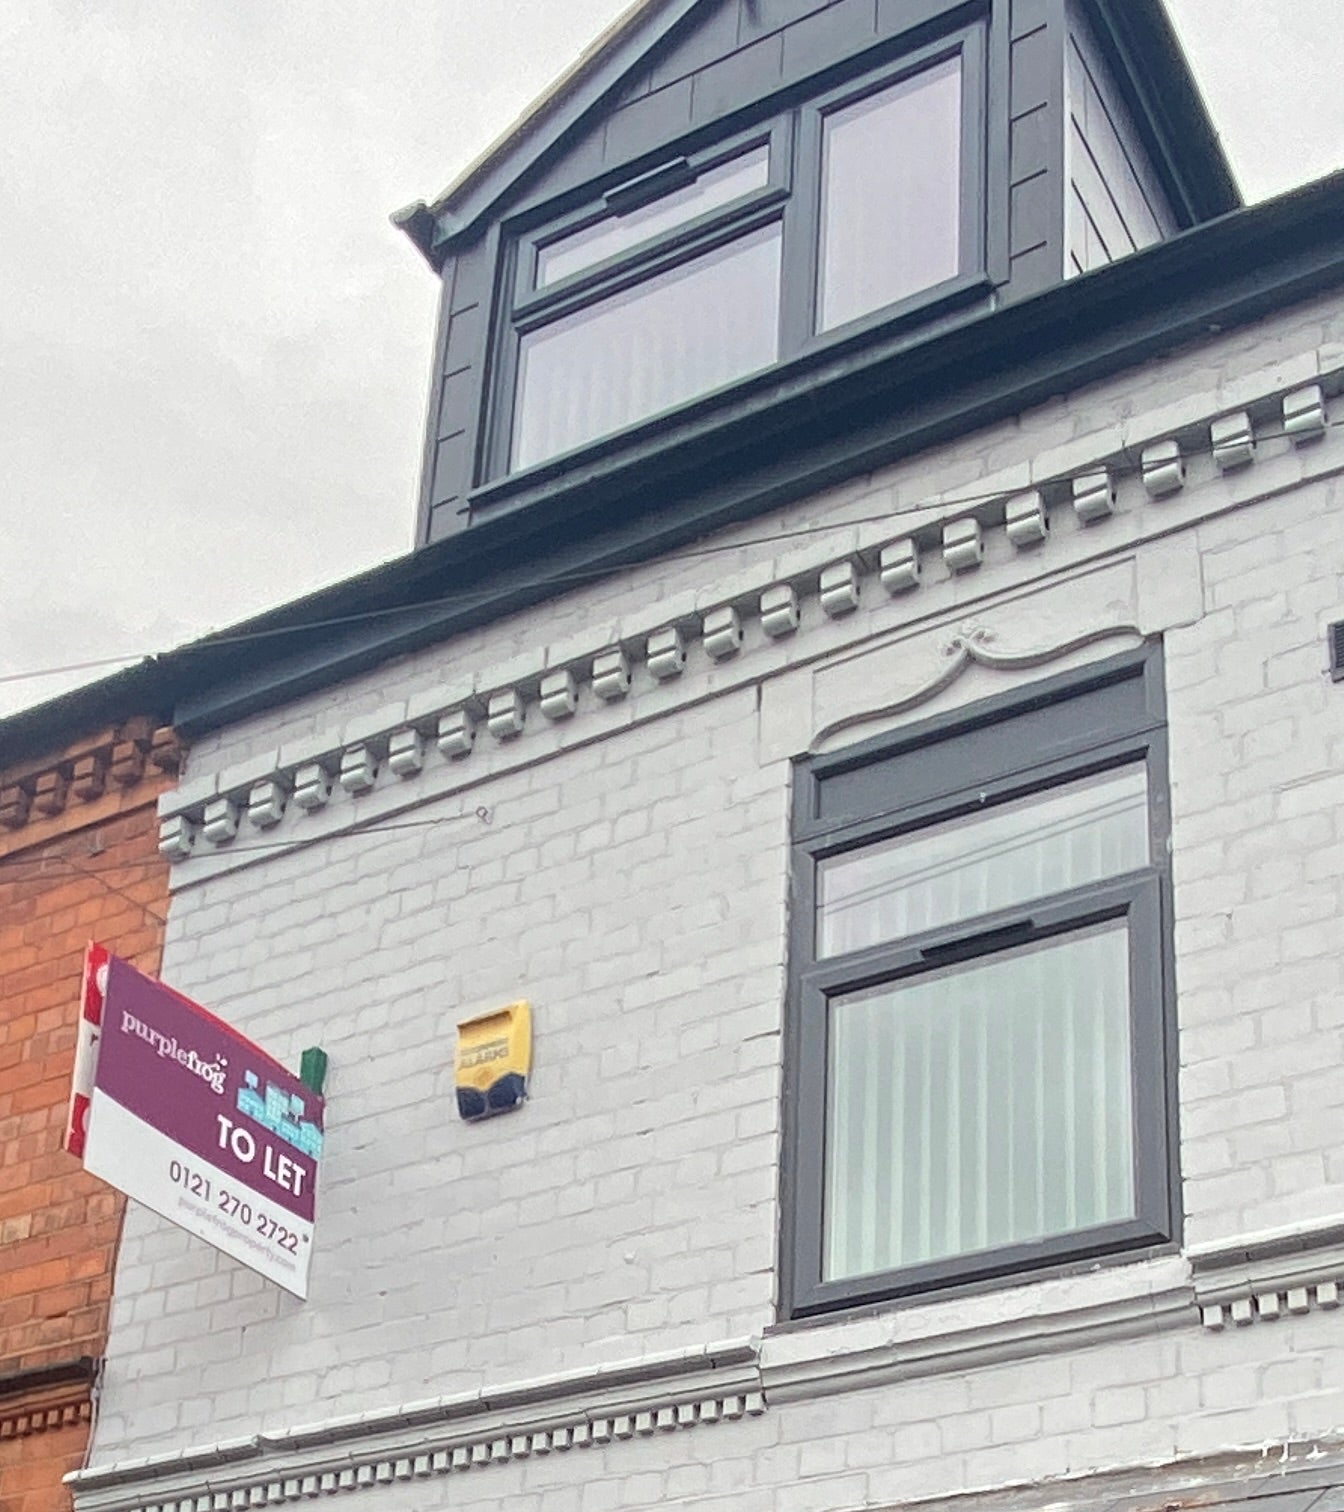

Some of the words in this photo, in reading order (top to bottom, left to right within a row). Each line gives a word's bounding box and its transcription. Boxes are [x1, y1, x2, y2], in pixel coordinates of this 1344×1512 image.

[120, 1010, 227, 1095] purplefrog
[217, 1113, 256, 1163] TO
[263, 1144, 306, 1196] LET
[169, 1159, 211, 1202] 0121
[218, 1189, 252, 1225] 270
[256, 1212, 299, 1257] 2722
